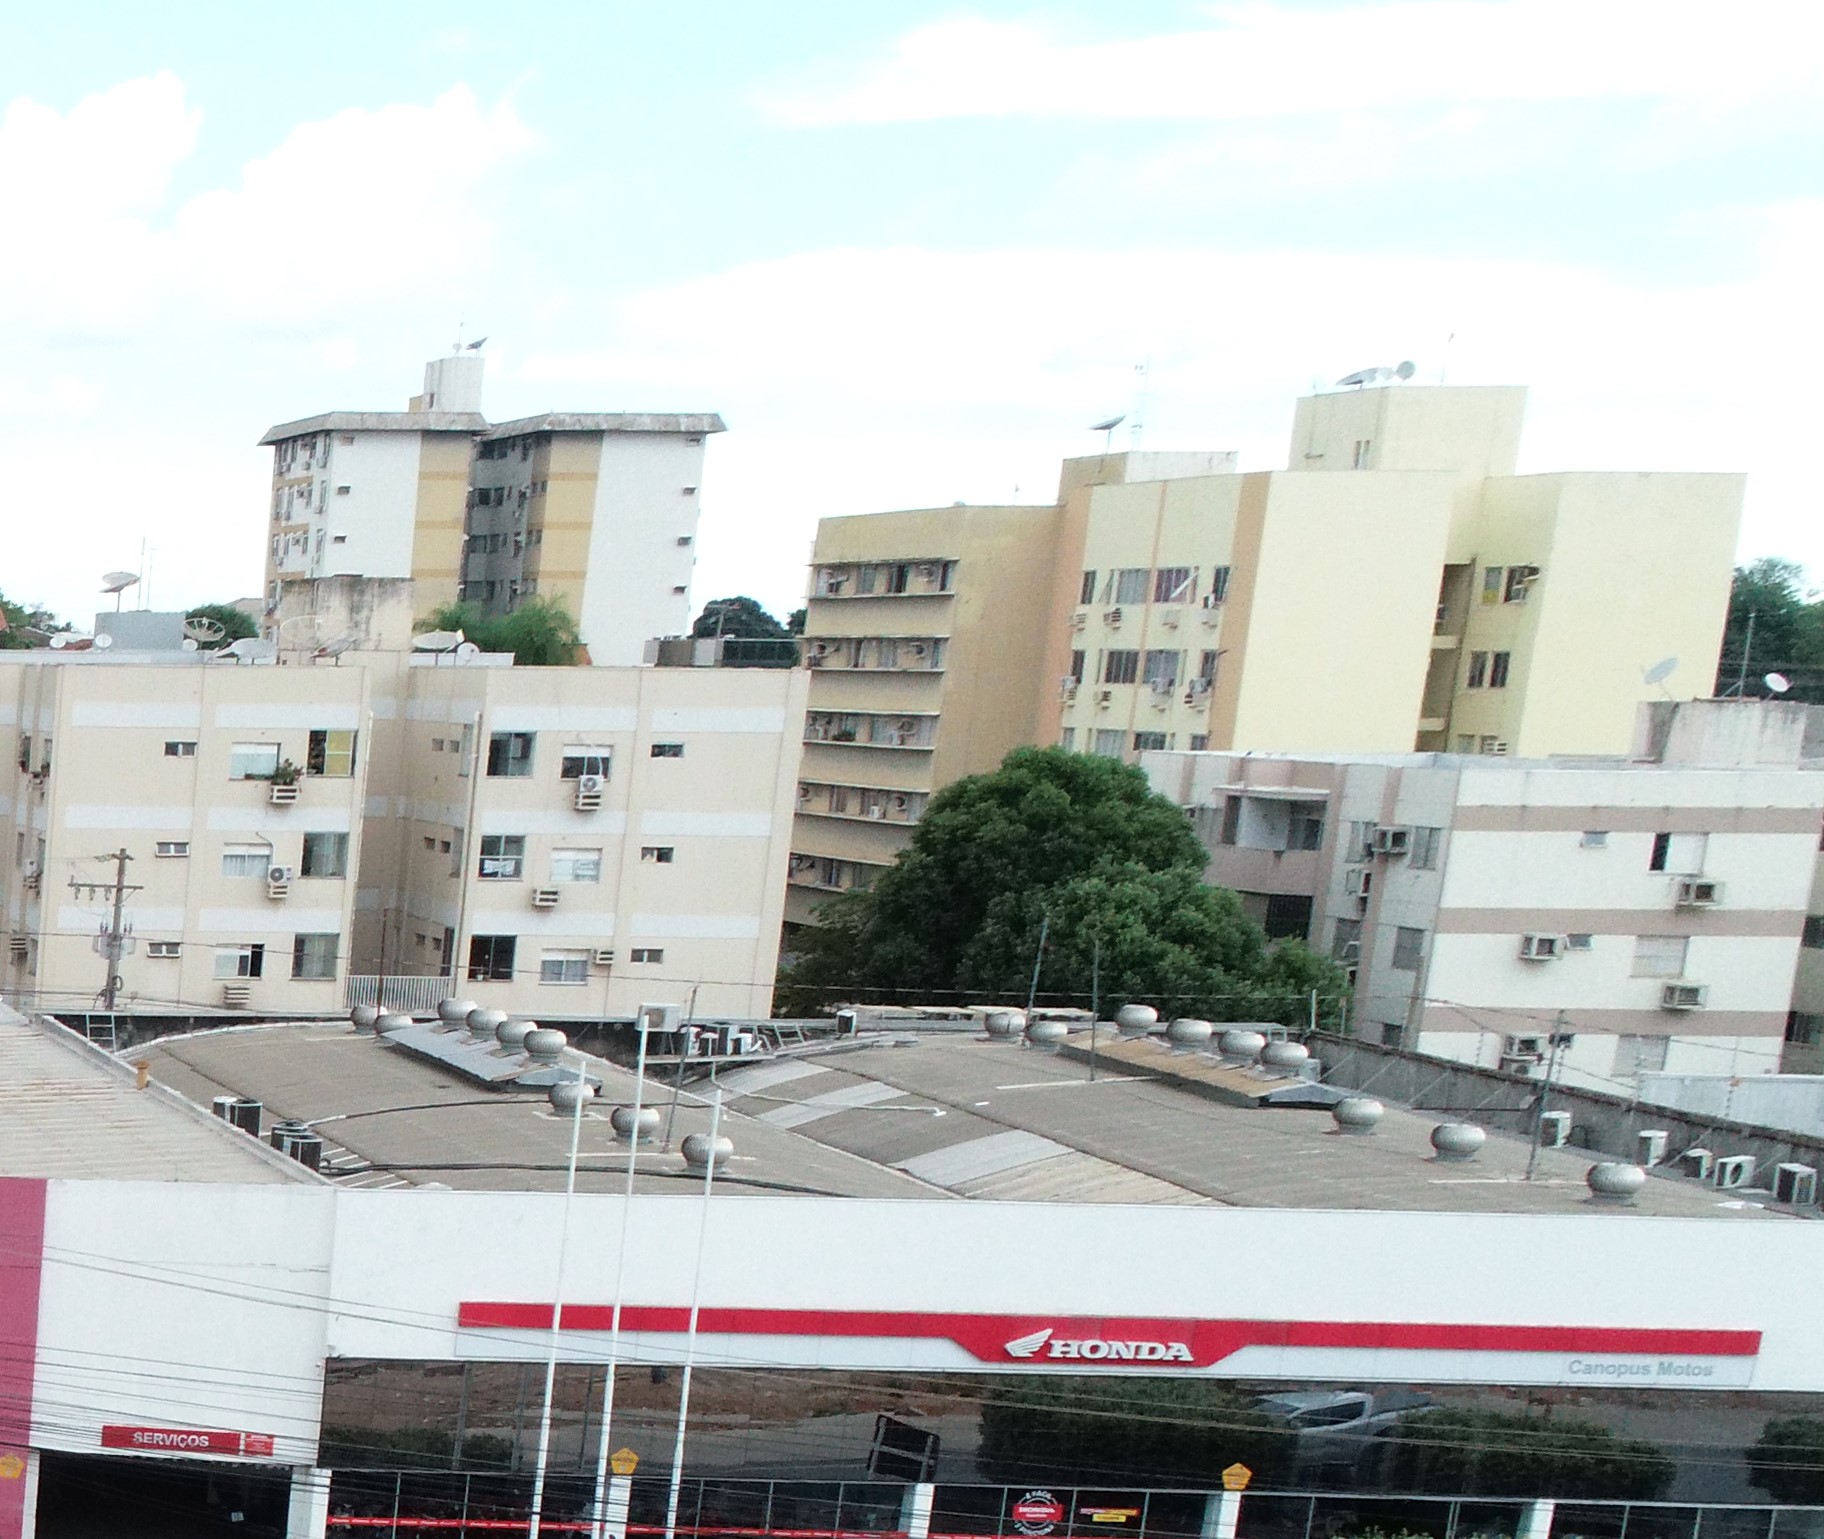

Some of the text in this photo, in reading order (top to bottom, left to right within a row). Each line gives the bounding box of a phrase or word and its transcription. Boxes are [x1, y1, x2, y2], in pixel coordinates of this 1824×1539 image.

[1047, 1340, 1194, 1361] HONDA
[1568, 1360, 1713, 1377] Canopus Motos
[133, 1432, 210, 1449] SERVIÇOS
